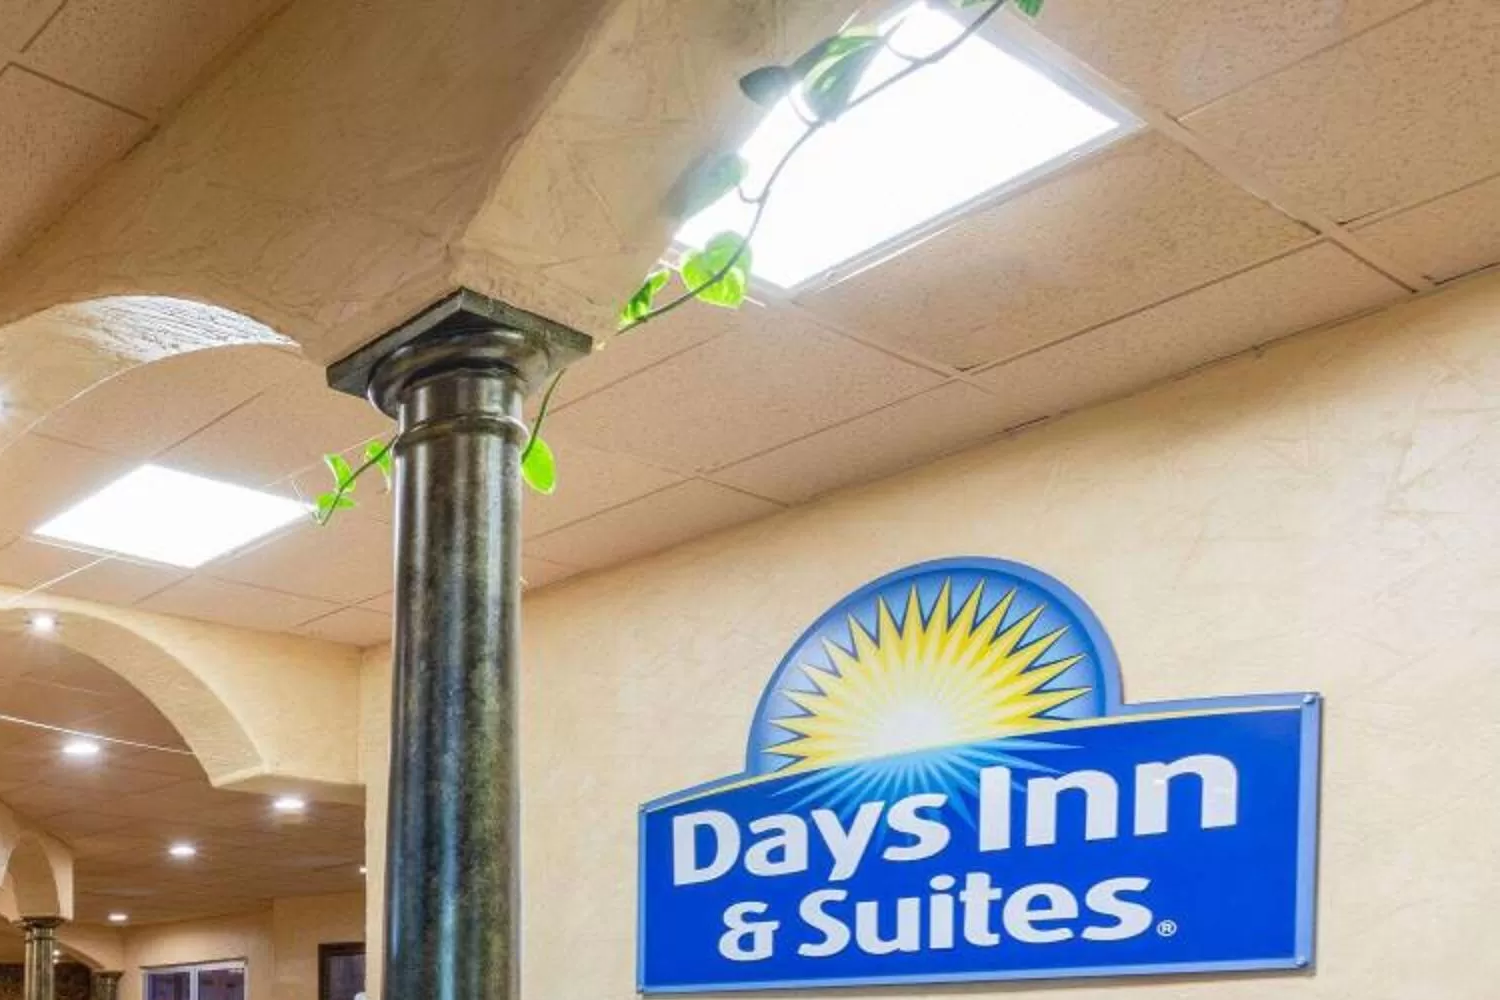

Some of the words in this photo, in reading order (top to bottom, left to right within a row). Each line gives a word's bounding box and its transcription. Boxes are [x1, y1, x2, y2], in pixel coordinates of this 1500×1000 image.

[673, 792, 950, 885] Days
[979, 754, 1238, 851] Inn
[719, 902, 779, 961] &
